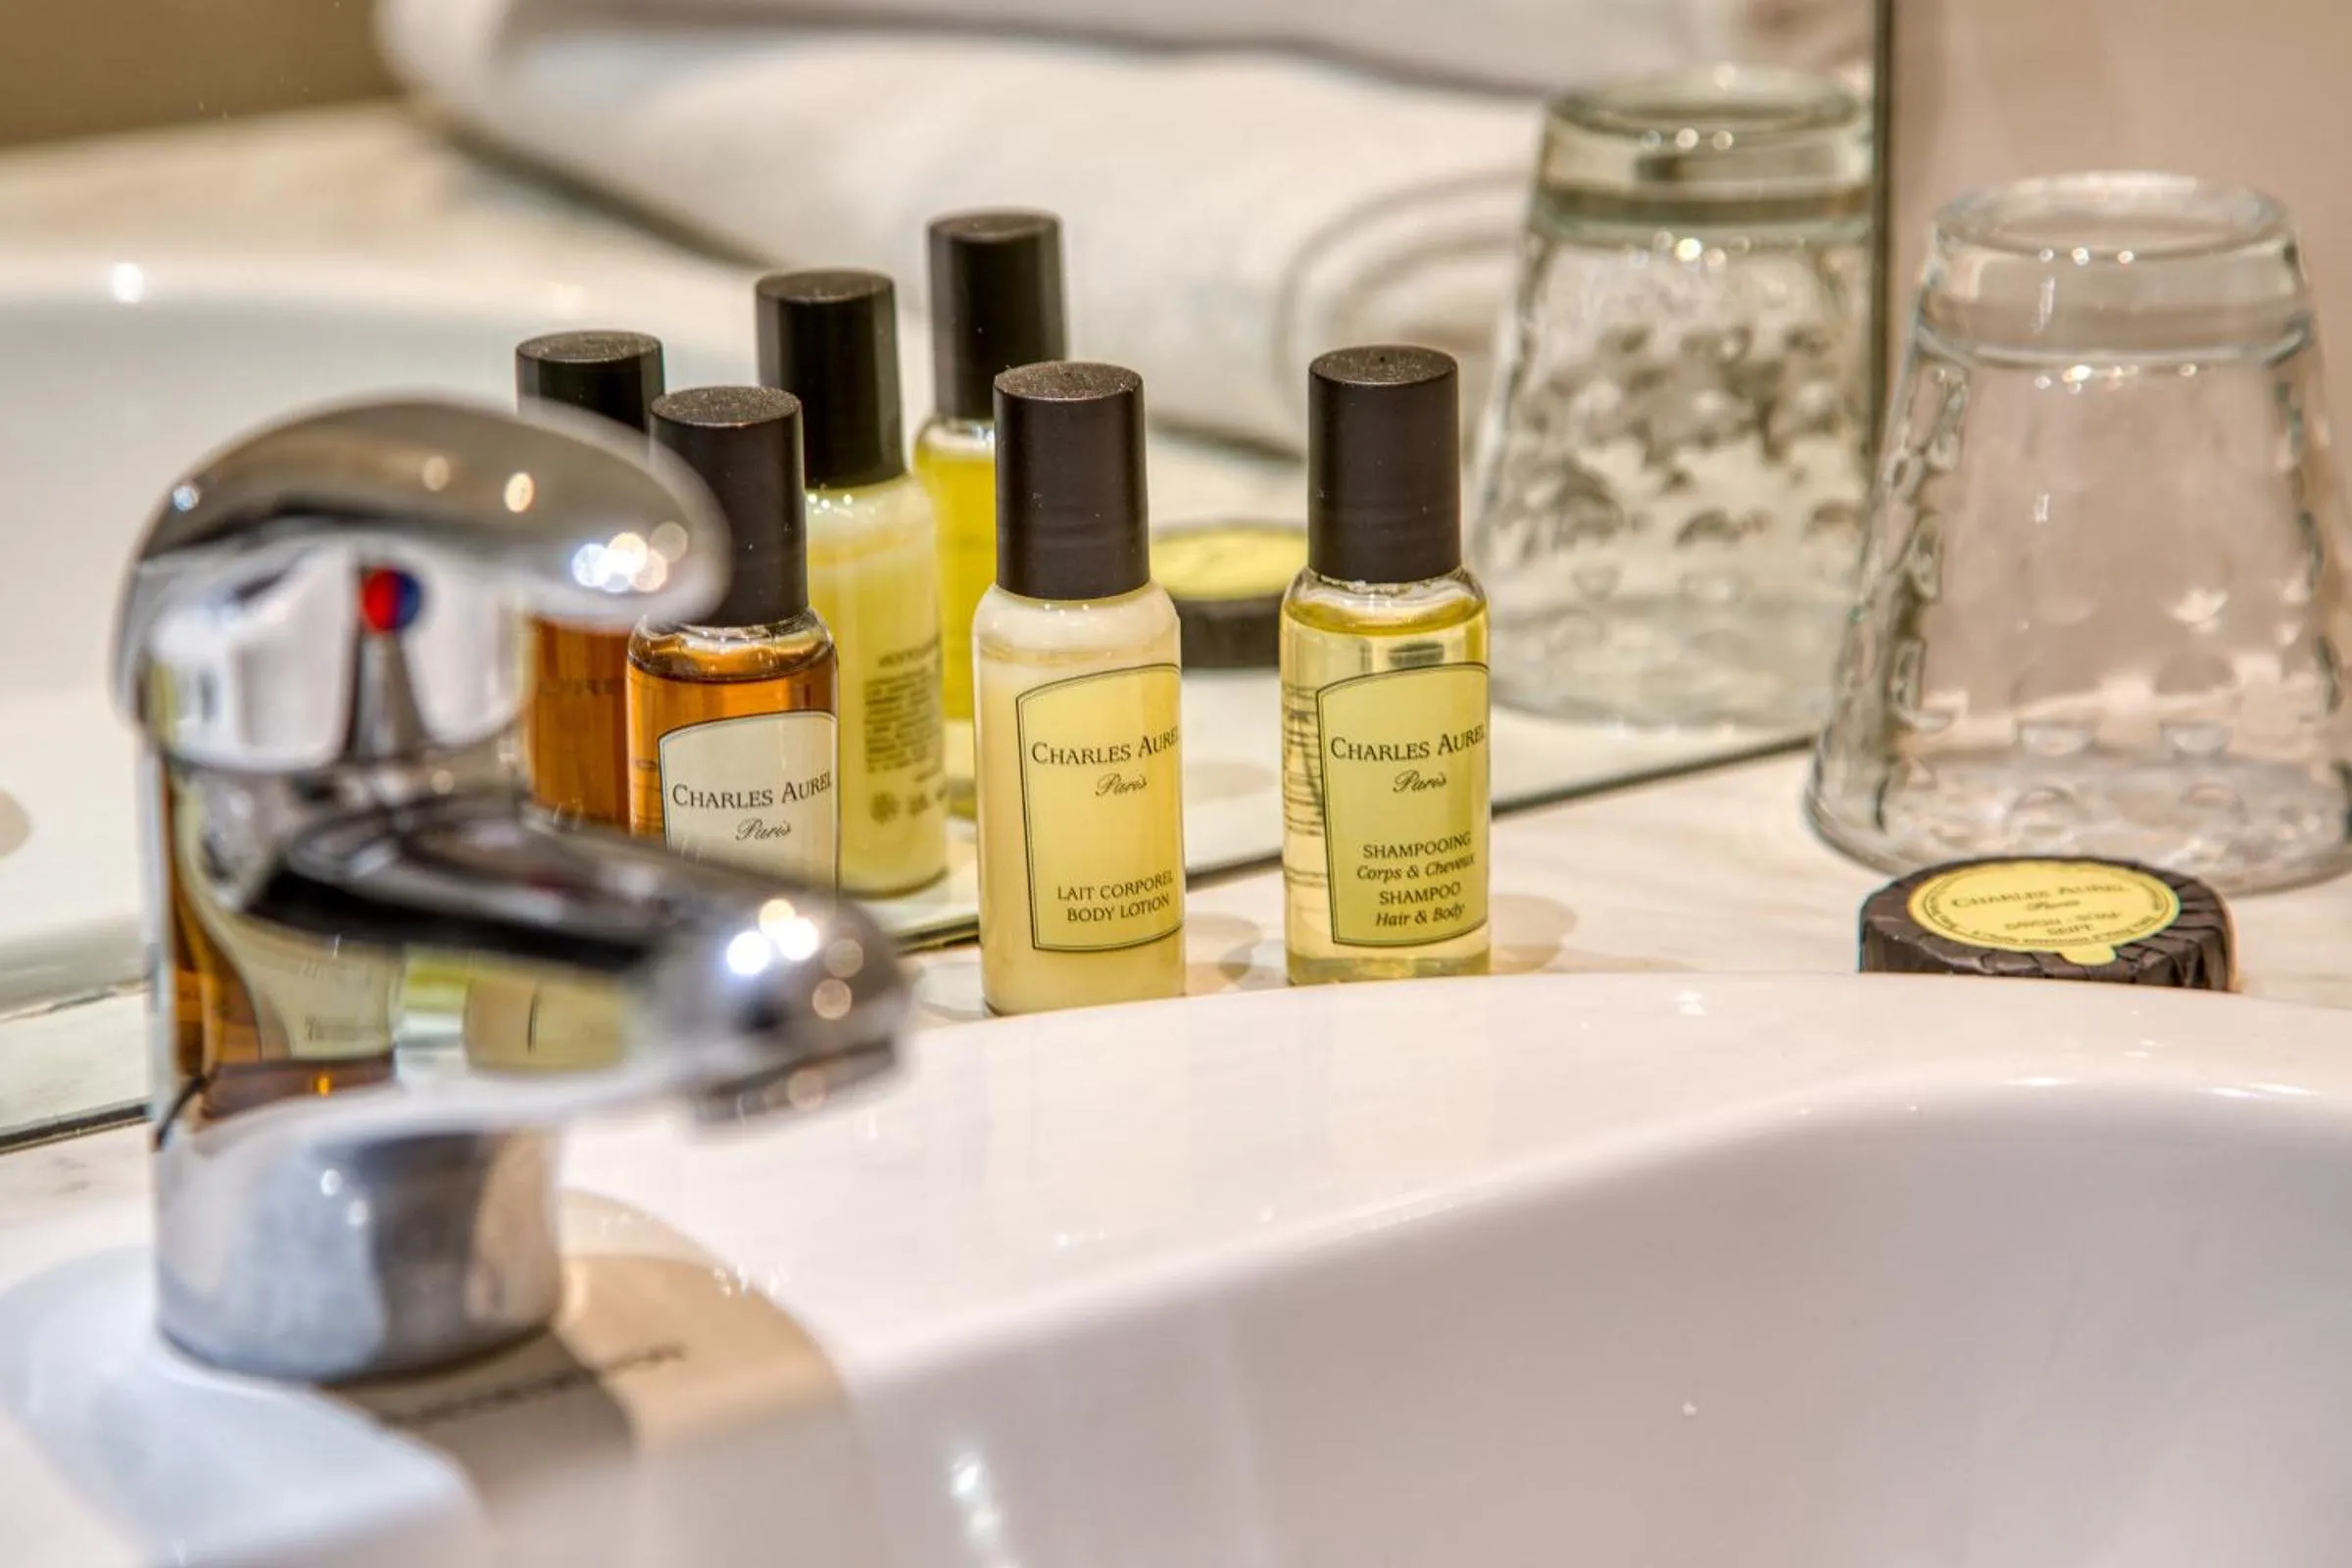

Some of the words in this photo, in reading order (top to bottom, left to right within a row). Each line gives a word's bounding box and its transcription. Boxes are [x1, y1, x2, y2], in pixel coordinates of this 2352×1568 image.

[1032, 741, 1131, 765] CHARLES
[1138, 725, 1179, 758] AURE
[1331, 736, 1431, 761] CHARLES
[672, 783, 774, 809] CHARLES
[781, 771, 833, 805] AUREL
[1095, 772, 1148, 797] Paris
[1393, 768, 1447, 794] Paris
[735, 817, 793, 841] Paris
[1363, 831, 1471, 859] SHAMPOOING
[1356, 864, 1401, 884] Corps
[1406, 864, 1419, 879] &
[1057, 885, 1096, 902] LAIT
[1379, 882, 1461, 906] SHAMPOO
[1067, 906, 1114, 922] BODY
[1120, 893, 1170, 919] LOTION
[1375, 912, 1411, 927] Hair
[1414, 909, 1428, 925] &
[1433, 903, 1465, 923] Body
